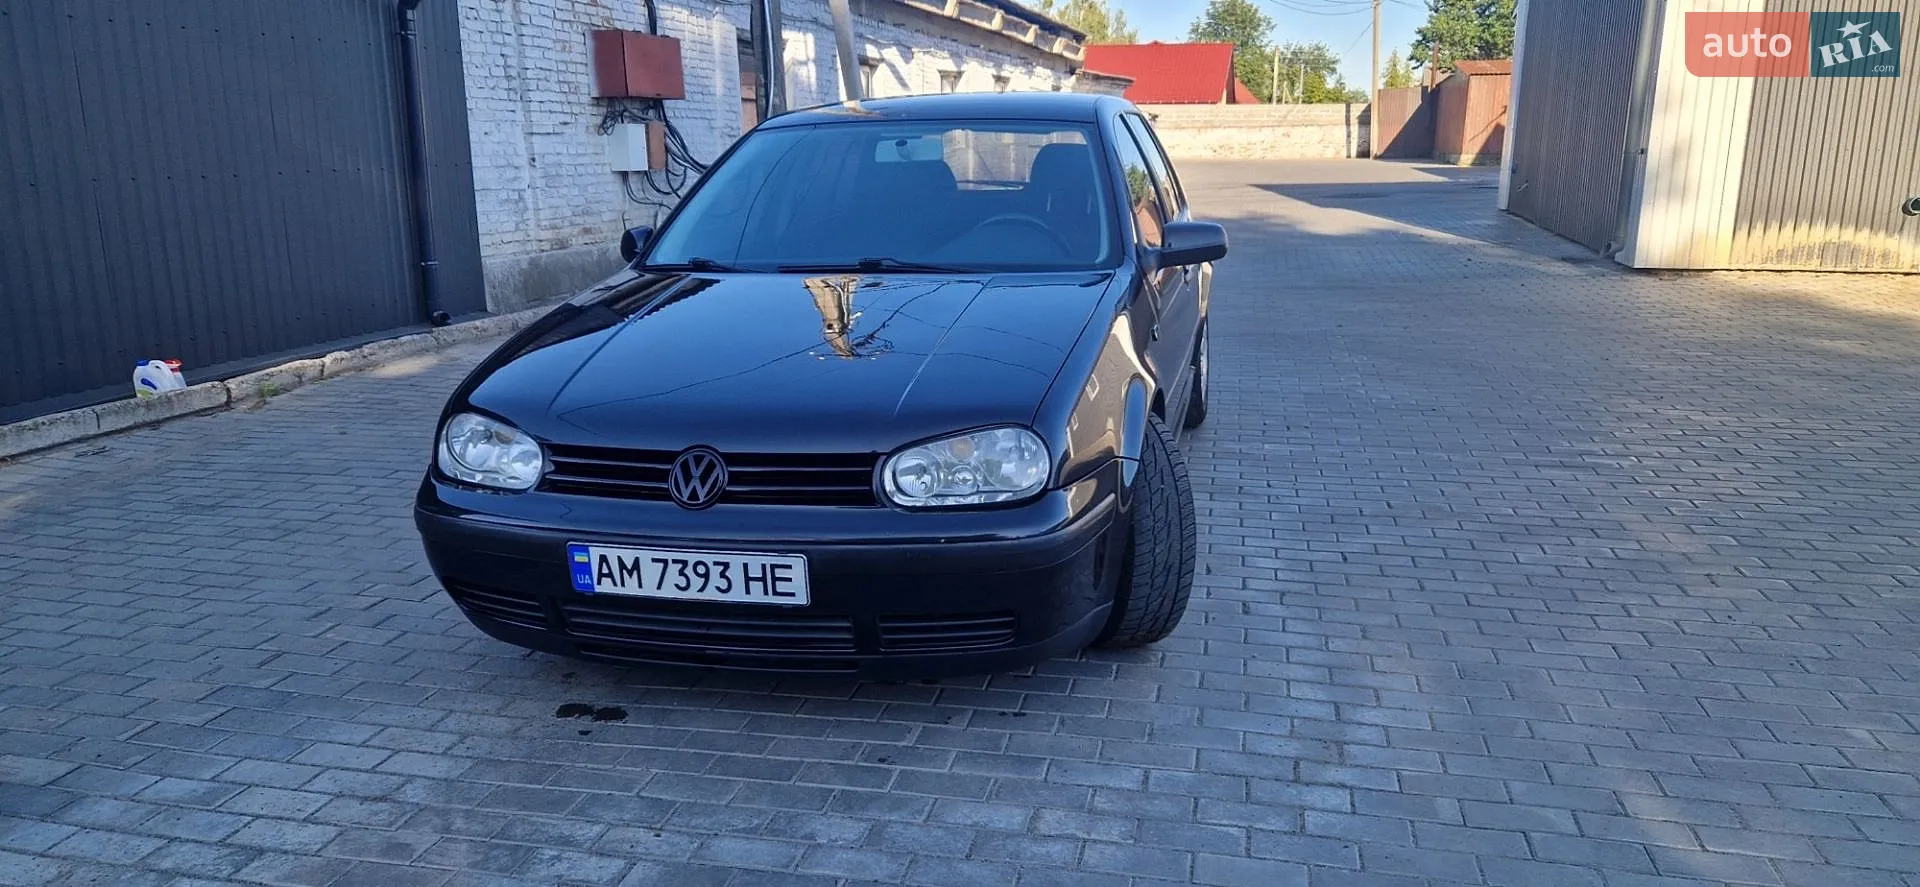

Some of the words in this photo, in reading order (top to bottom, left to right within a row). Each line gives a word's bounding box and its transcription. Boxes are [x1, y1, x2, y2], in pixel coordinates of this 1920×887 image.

[672, 449, 724, 504] VW
[577, 573, 592, 585] UA
[596, 554, 643, 589] AM
[651, 557, 733, 594] 7393
[742, 562, 796, 598] HE
